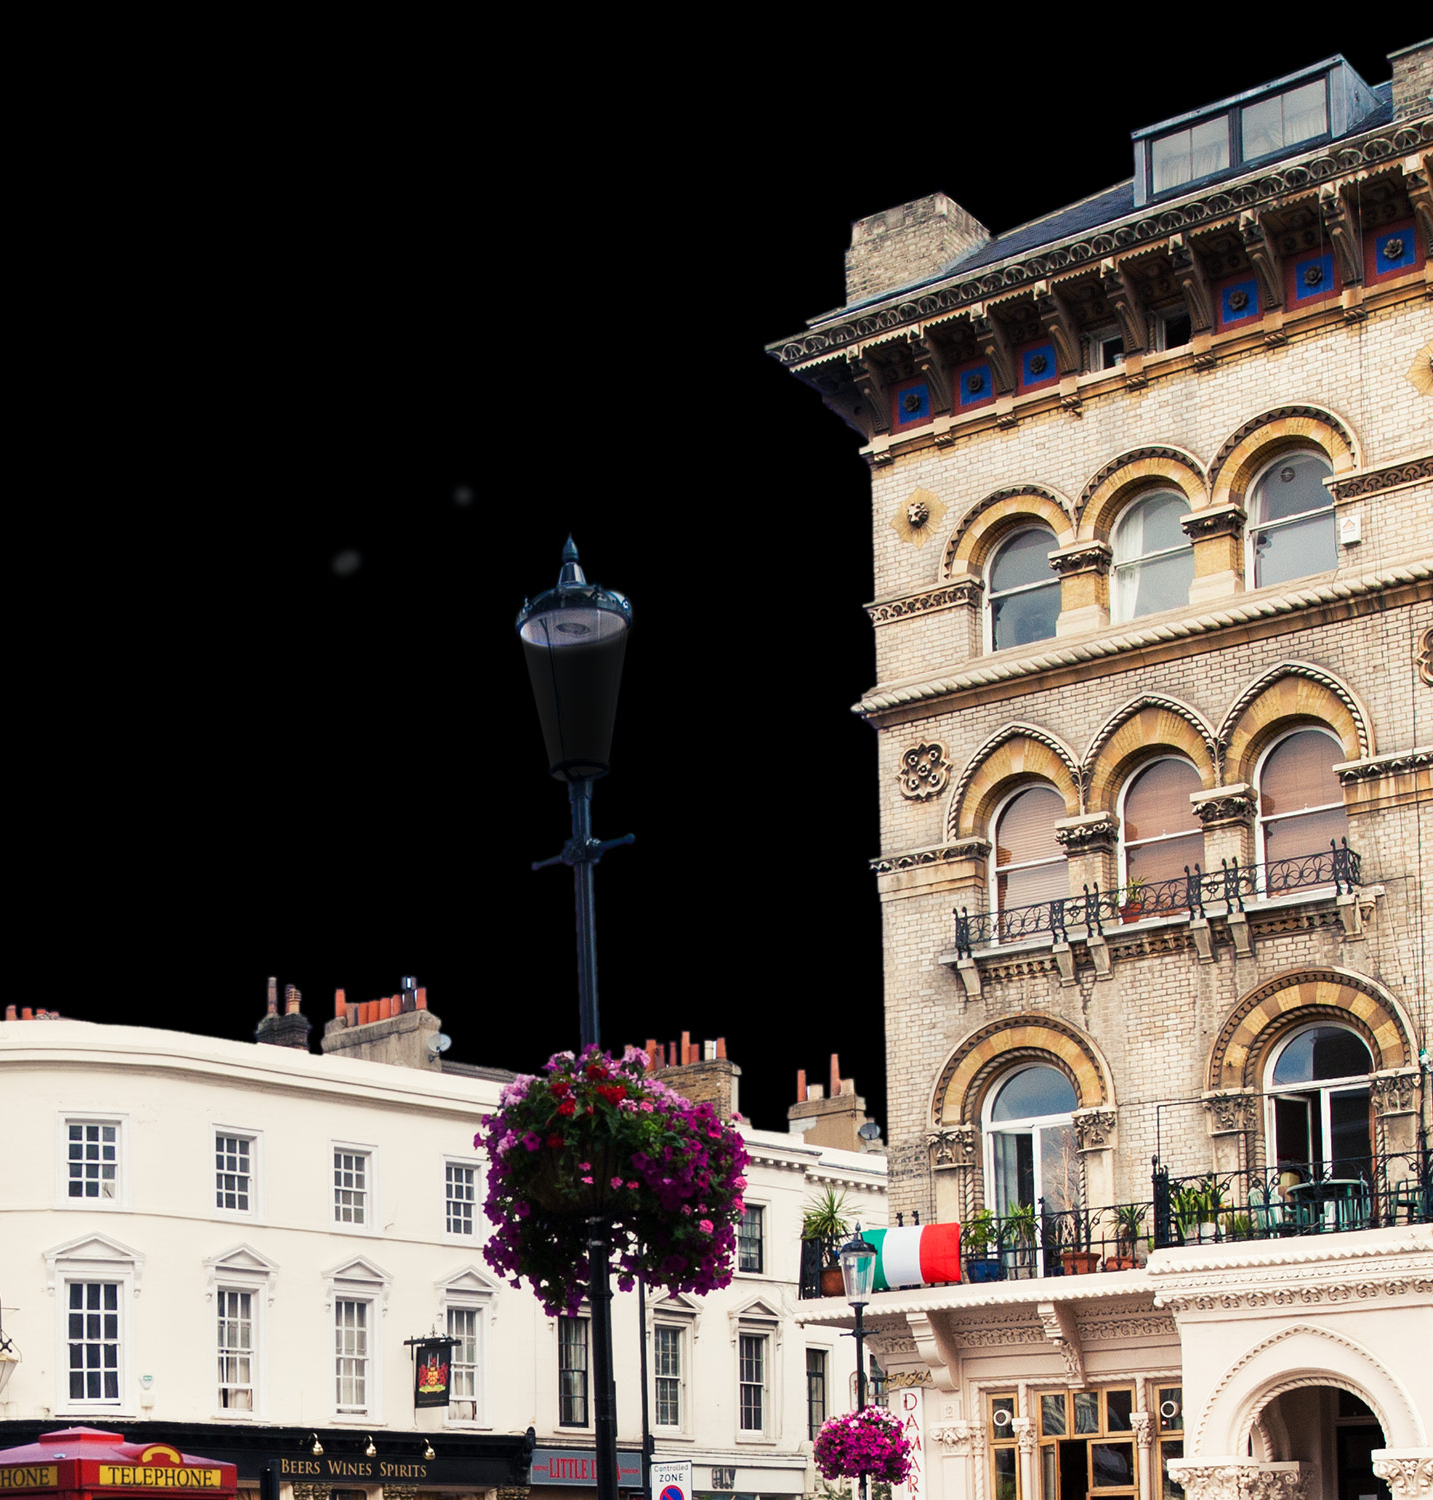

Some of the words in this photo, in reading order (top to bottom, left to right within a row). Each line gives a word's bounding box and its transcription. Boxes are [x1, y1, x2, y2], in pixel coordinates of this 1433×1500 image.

[108, 1466, 215, 1488] TELEPHONE
[281, 1458, 320, 1474] BEERS
[327, 1460, 372, 1476] WINES
[380, 1461, 427, 1477] SPIRITS
[549, 1458, 588, 1480] LITTLE
[654, 1464, 689, 1472] Controlled
[659, 1473, 684, 1482] ZONE
